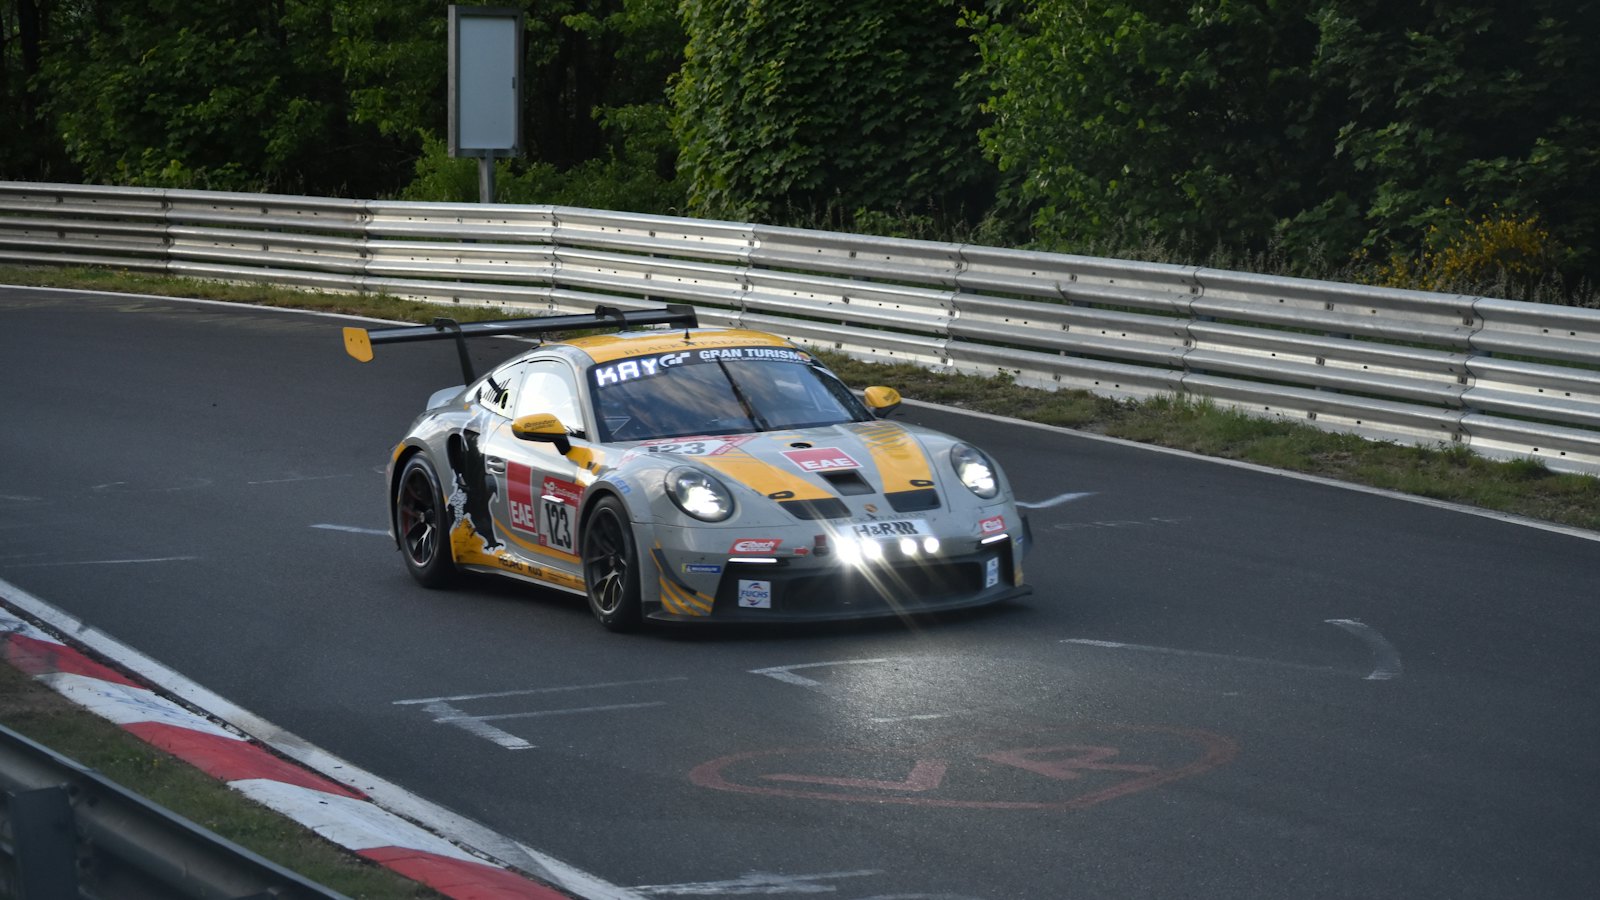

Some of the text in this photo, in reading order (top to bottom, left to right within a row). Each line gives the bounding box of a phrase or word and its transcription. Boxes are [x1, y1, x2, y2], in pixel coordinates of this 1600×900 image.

[699, 349, 741, 359] GRAN
[595, 358, 657, 387] KAY
[800, 458, 855, 470] EAE
[510, 500, 534, 528] EAE
[545, 503, 572, 549] 123
[851, 522, 896, 537] H&R
[740, 590, 769, 599] FUCHS
